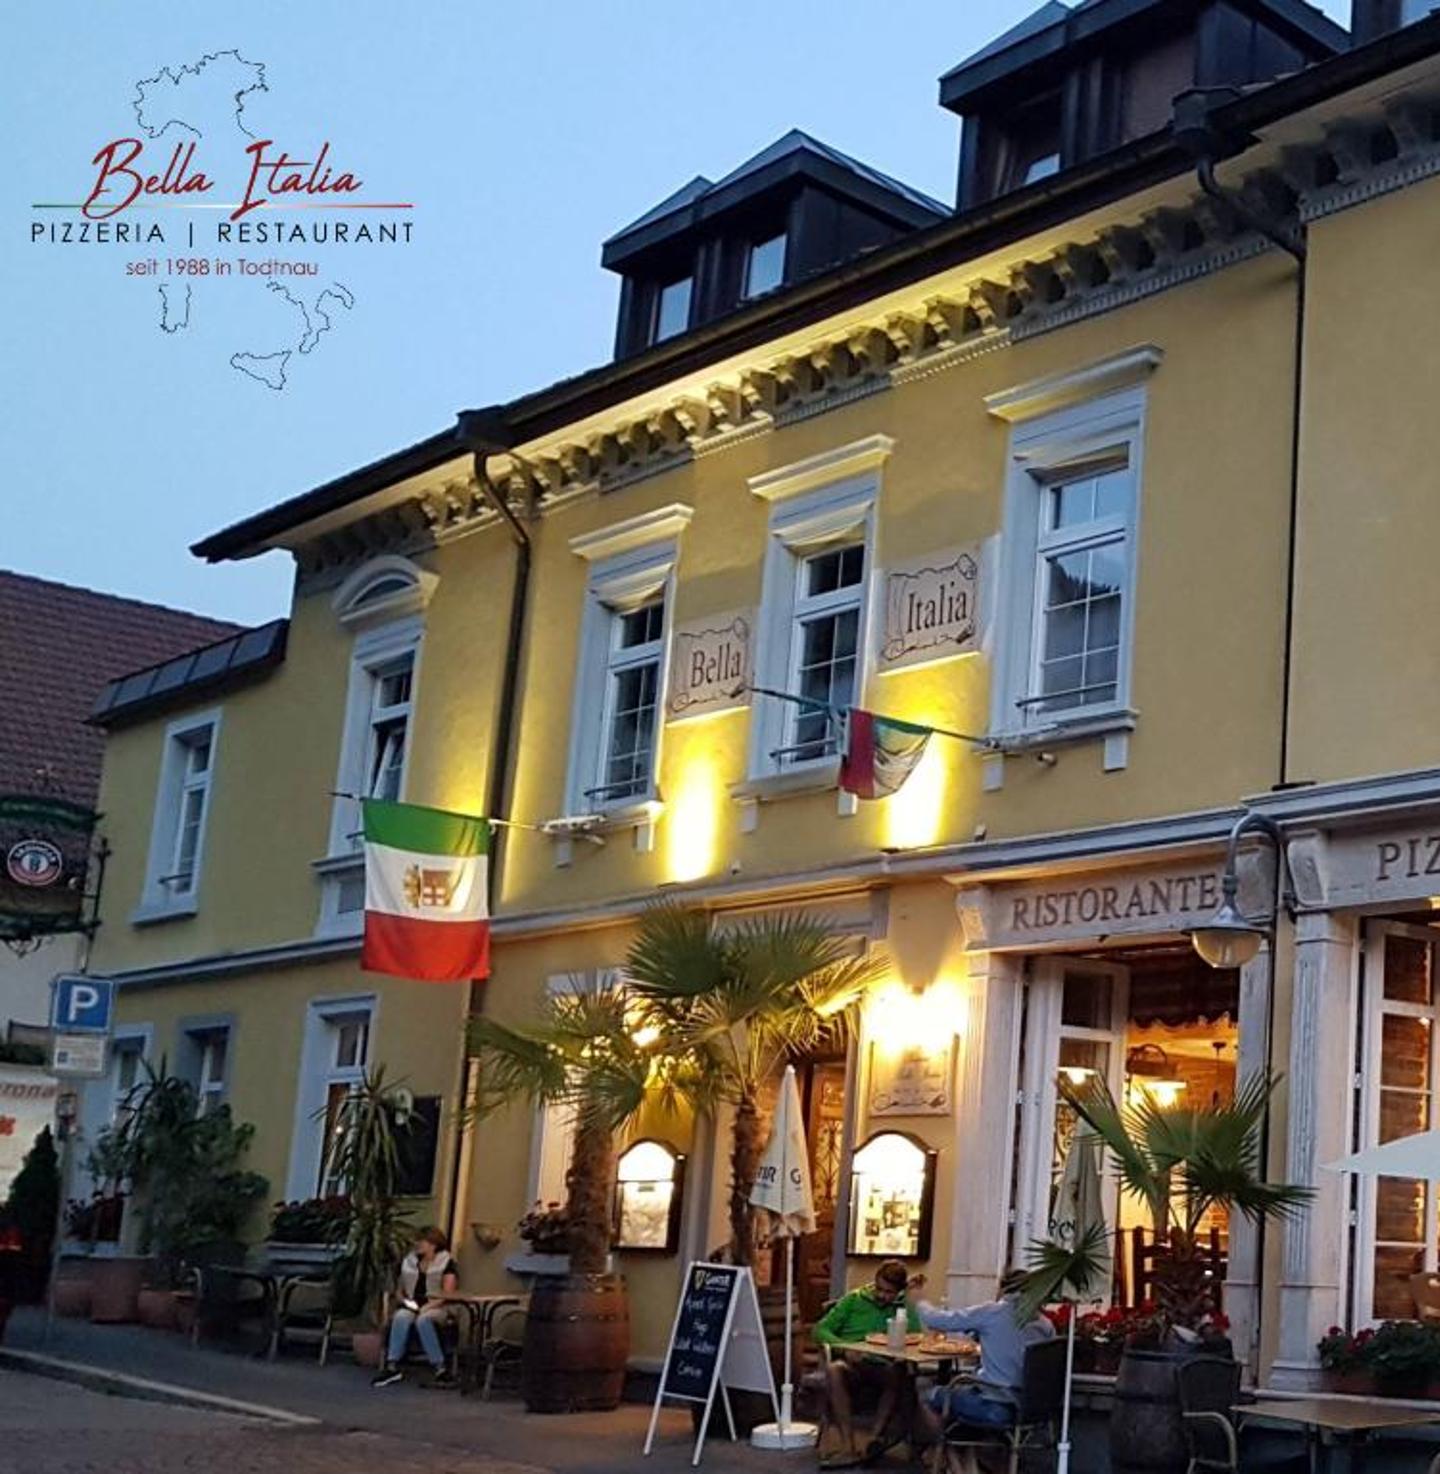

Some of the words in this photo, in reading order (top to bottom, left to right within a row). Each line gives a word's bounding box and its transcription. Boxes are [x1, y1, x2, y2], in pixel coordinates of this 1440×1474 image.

[906, 580, 967, 634] Italia
[689, 643, 742, 688] Bella
[1012, 874, 1220, 931] RISTORANTE
[68, 985, 99, 1022] P
